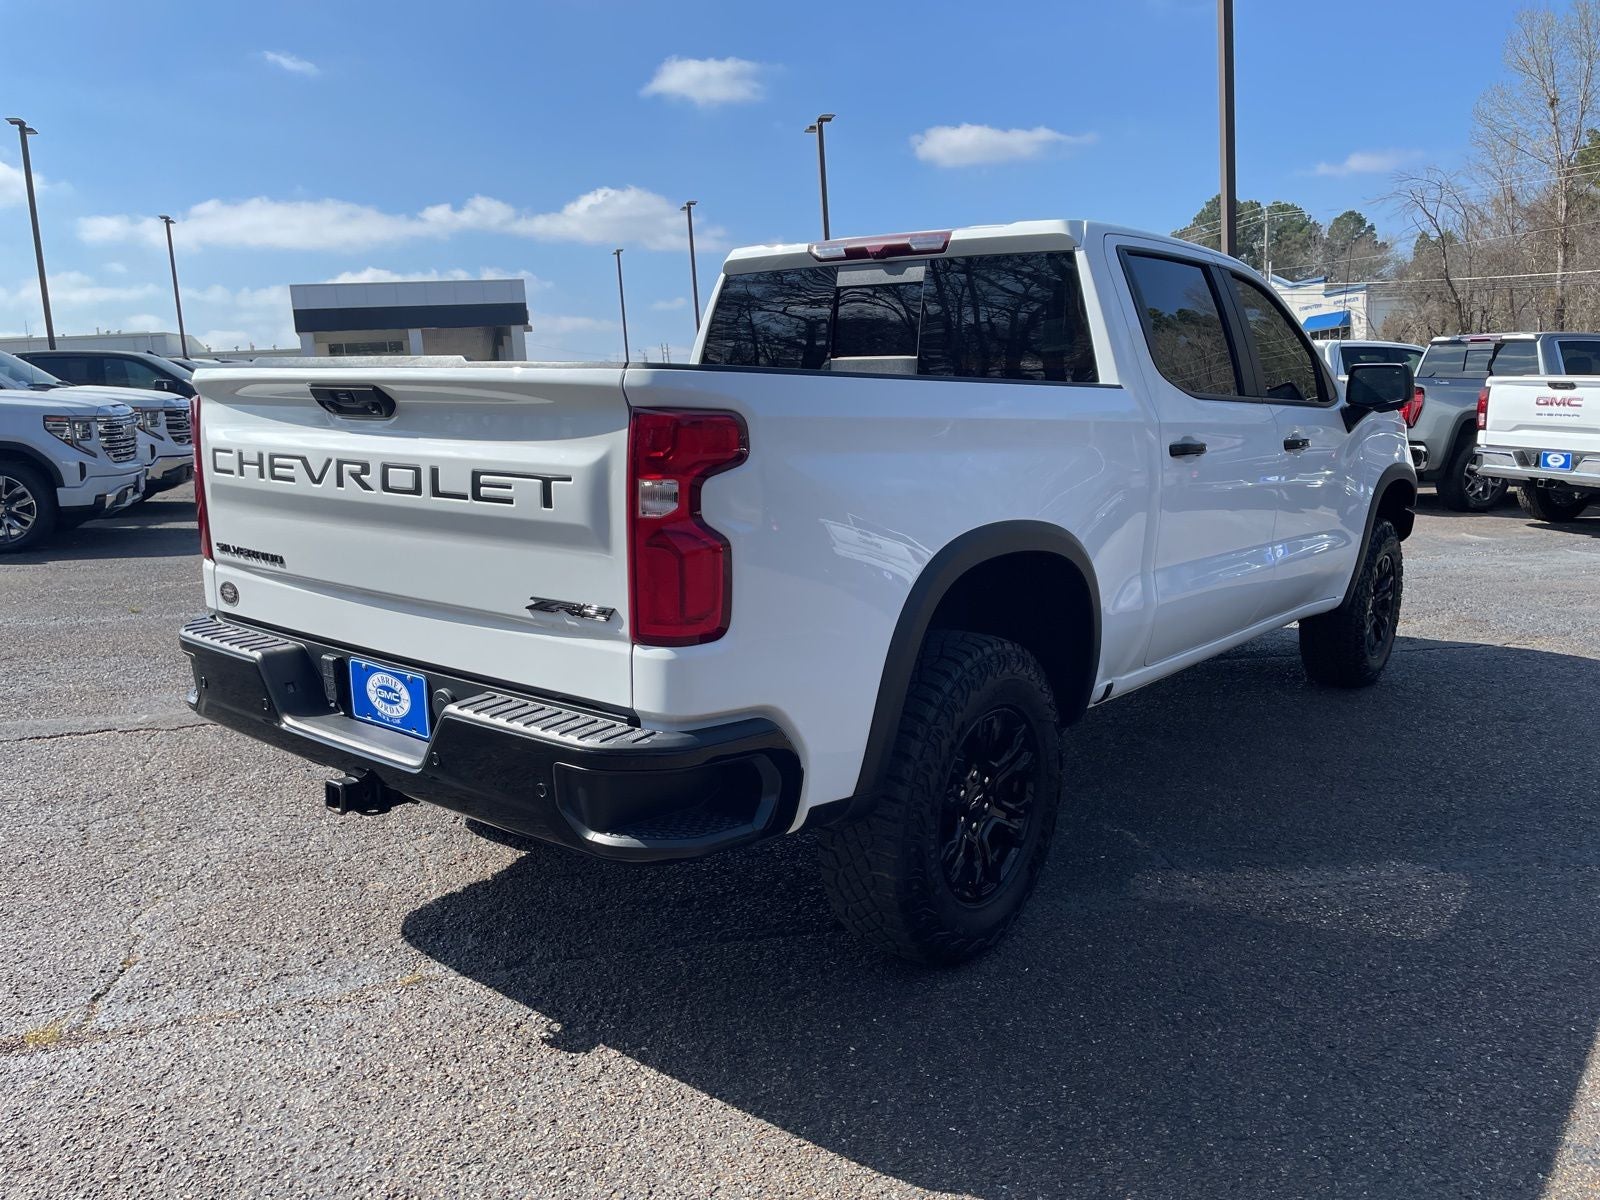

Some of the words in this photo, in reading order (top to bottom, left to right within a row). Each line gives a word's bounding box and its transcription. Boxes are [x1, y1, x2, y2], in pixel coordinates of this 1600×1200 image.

[1536, 396, 1584, 407] GMC
[211, 447, 573, 510] CHEVROLET
[216, 542, 284, 564] SILVERADO
[371, 675, 403, 692] GABRIEL
[377, 689, 400, 702] GMC
[373, 697, 405, 714] JORDAN
